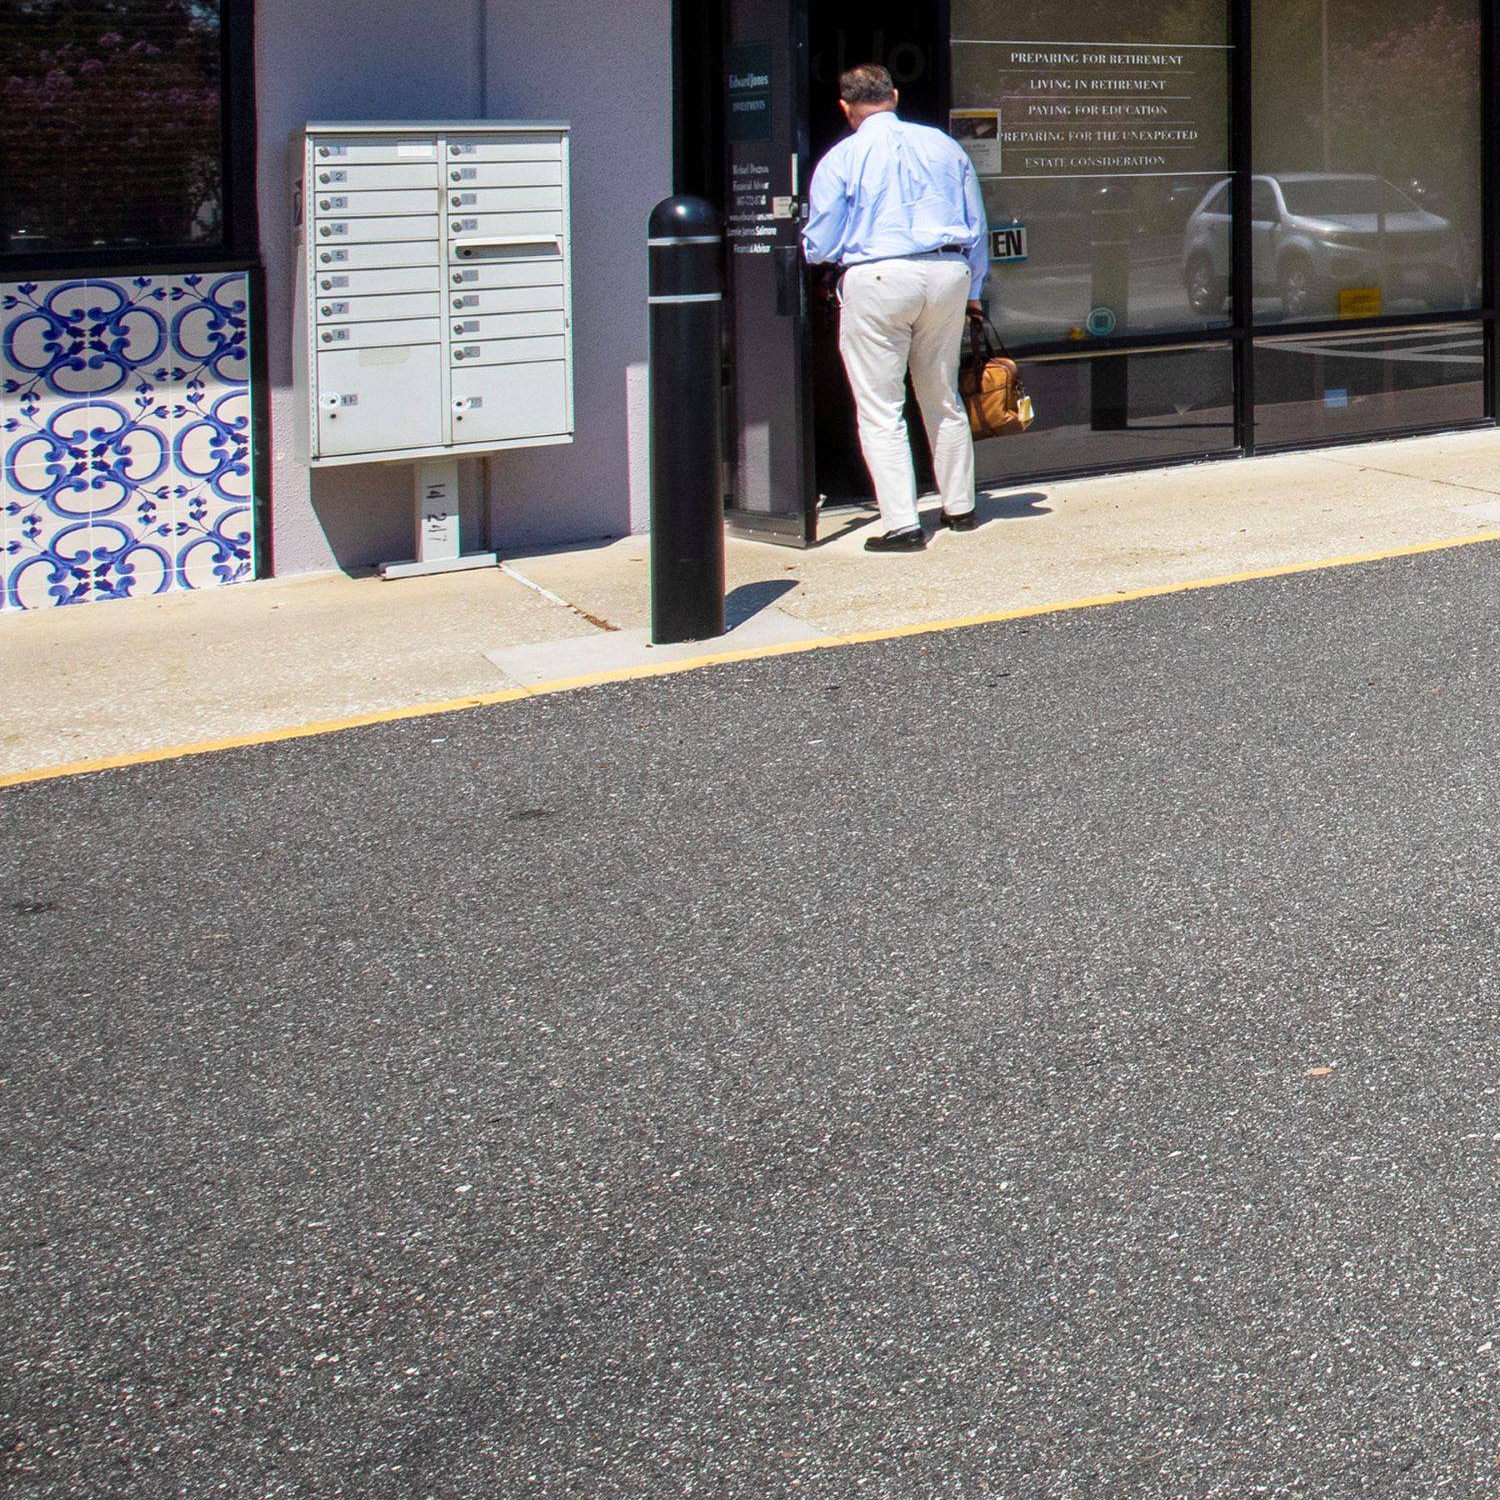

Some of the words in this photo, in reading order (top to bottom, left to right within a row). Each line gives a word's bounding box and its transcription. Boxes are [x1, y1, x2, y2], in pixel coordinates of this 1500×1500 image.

[1011, 53, 1079, 65] PREPARING
[1083, 54, 1106, 65] FOR
[1109, 54, 1184, 66] RETIREMENT
[1030, 80, 1071, 90] LIVING
[1075, 80, 1088, 90] IN
[1091, 80, 1167, 90] RETIREMENT
[1029, 105, 1071, 116] PAYING
[1075, 106, 1099, 116] FOR
[1102, 105, 1168, 116] EDUCATION
[997, 132, 1065, 142] PREPARING
[1069, 131, 1092, 141] FOR
[1096, 131, 1120, 141] THE
[1123, 130, 1198, 141] UNEXPECTED
[1025, 157, 1066, 169] ESTATE
[1070, 156, 1166, 167] CONSIDERATION
[335, 171, 343, 181] 2
[335, 197, 343, 207] 3
[335, 224, 343, 233] 4
[988, 230, 1024, 258] EN
[336, 251, 344, 260] 5
[337, 303, 345, 313] 7
